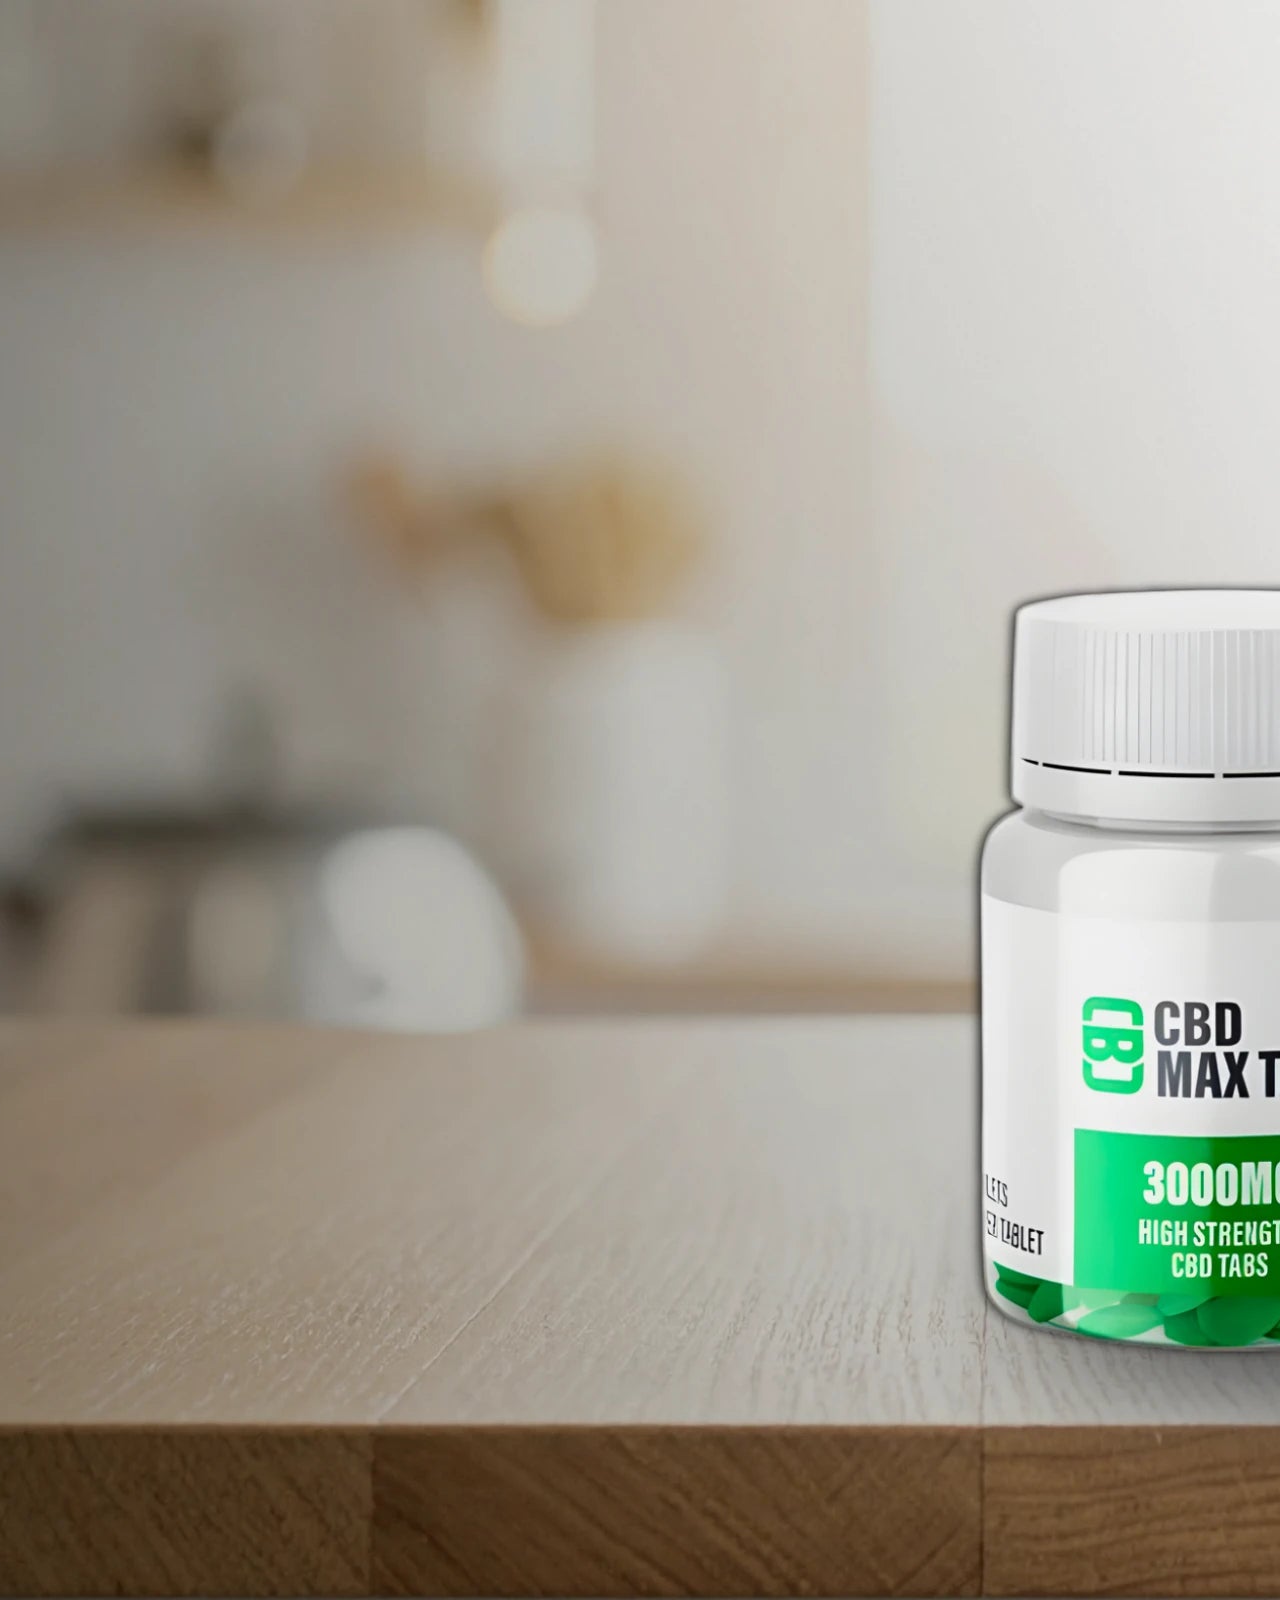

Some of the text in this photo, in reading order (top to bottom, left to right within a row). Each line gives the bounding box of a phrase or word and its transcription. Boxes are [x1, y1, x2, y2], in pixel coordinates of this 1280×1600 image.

[1154, 1001, 1242, 1046] CBD
[1157, 1052, 1249, 1098] MAX
[1139, 1220, 1187, 1245] HIGH
[1172, 1253, 1268, 1277] CBD TABS
